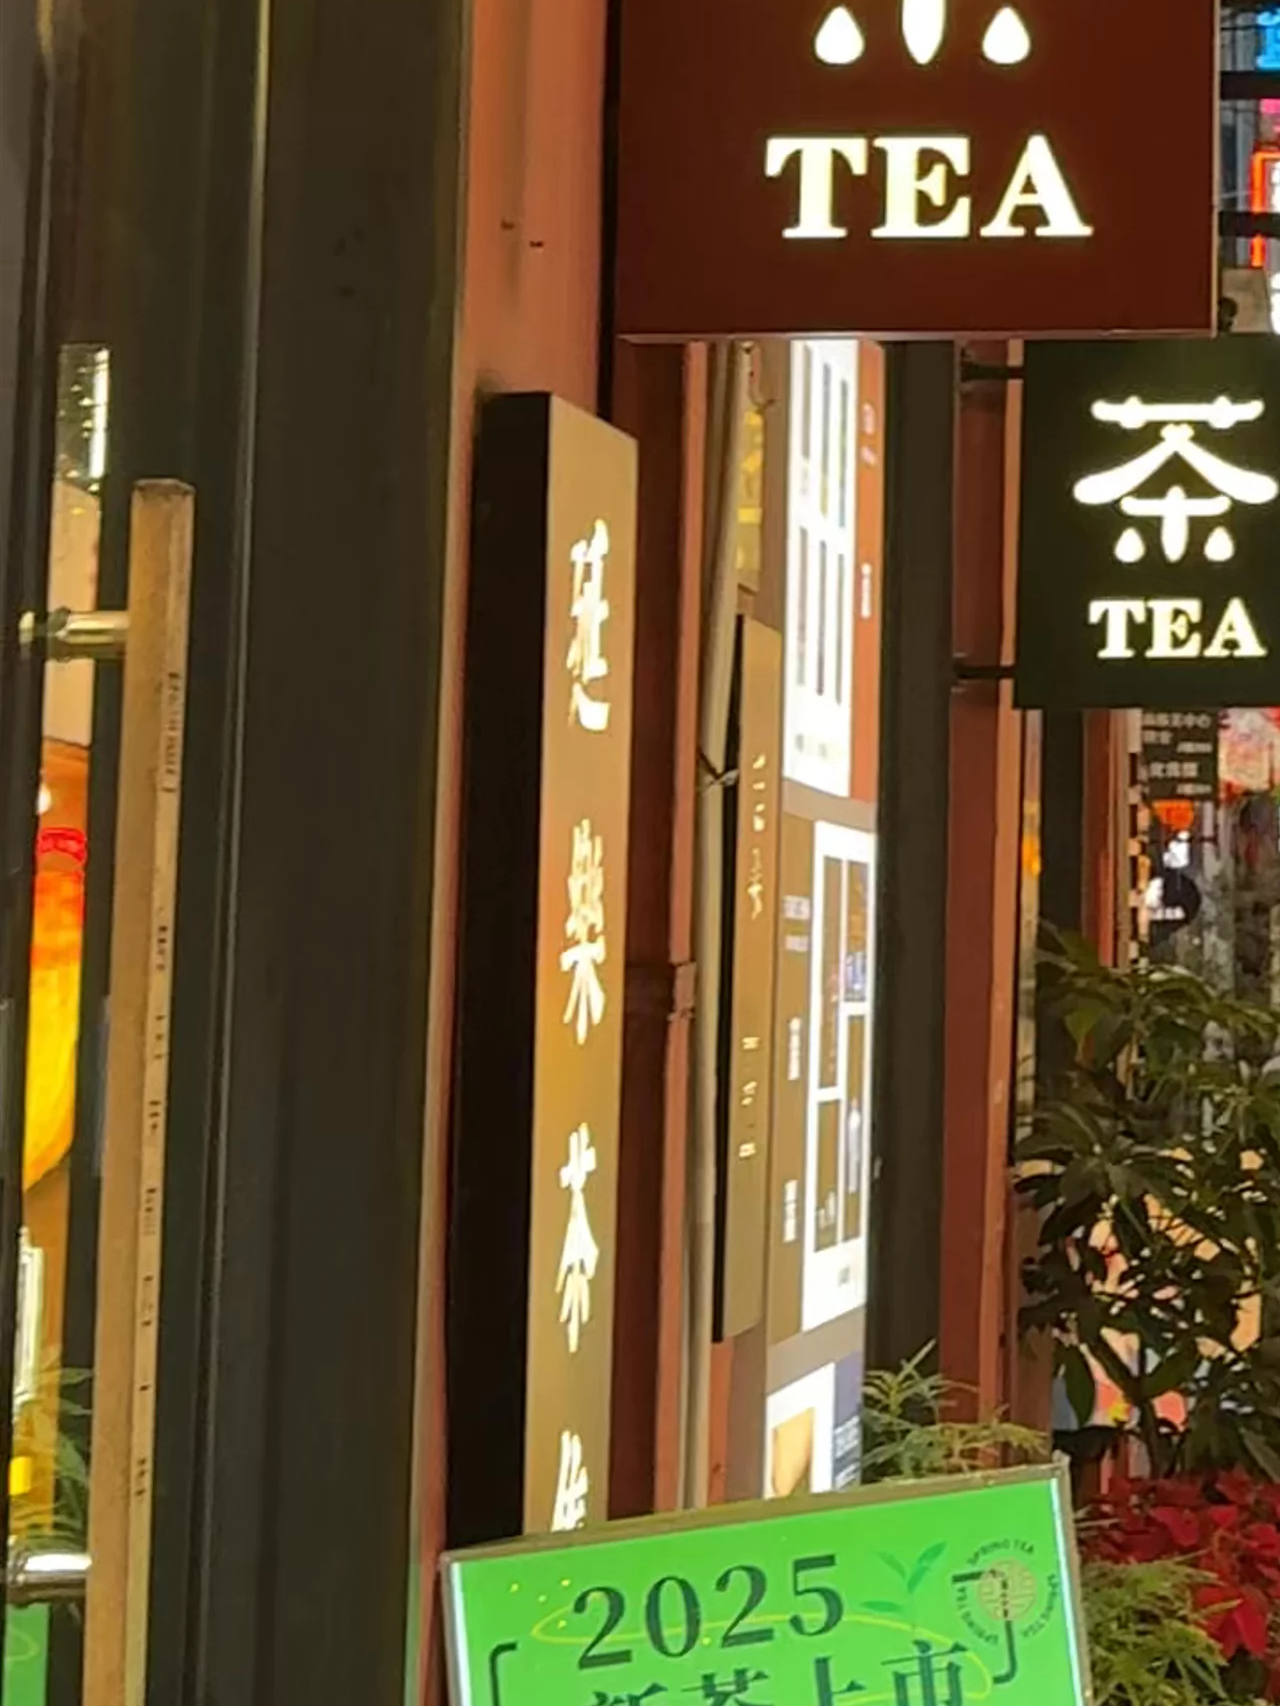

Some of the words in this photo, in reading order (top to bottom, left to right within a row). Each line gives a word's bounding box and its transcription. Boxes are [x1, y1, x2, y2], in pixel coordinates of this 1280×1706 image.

[765, 135, 1094, 238] TEA
[1072, 395, 1280, 564] 茶
[1088, 597, 1268, 659] TEA
[572, 1554, 845, 1671] 2025
